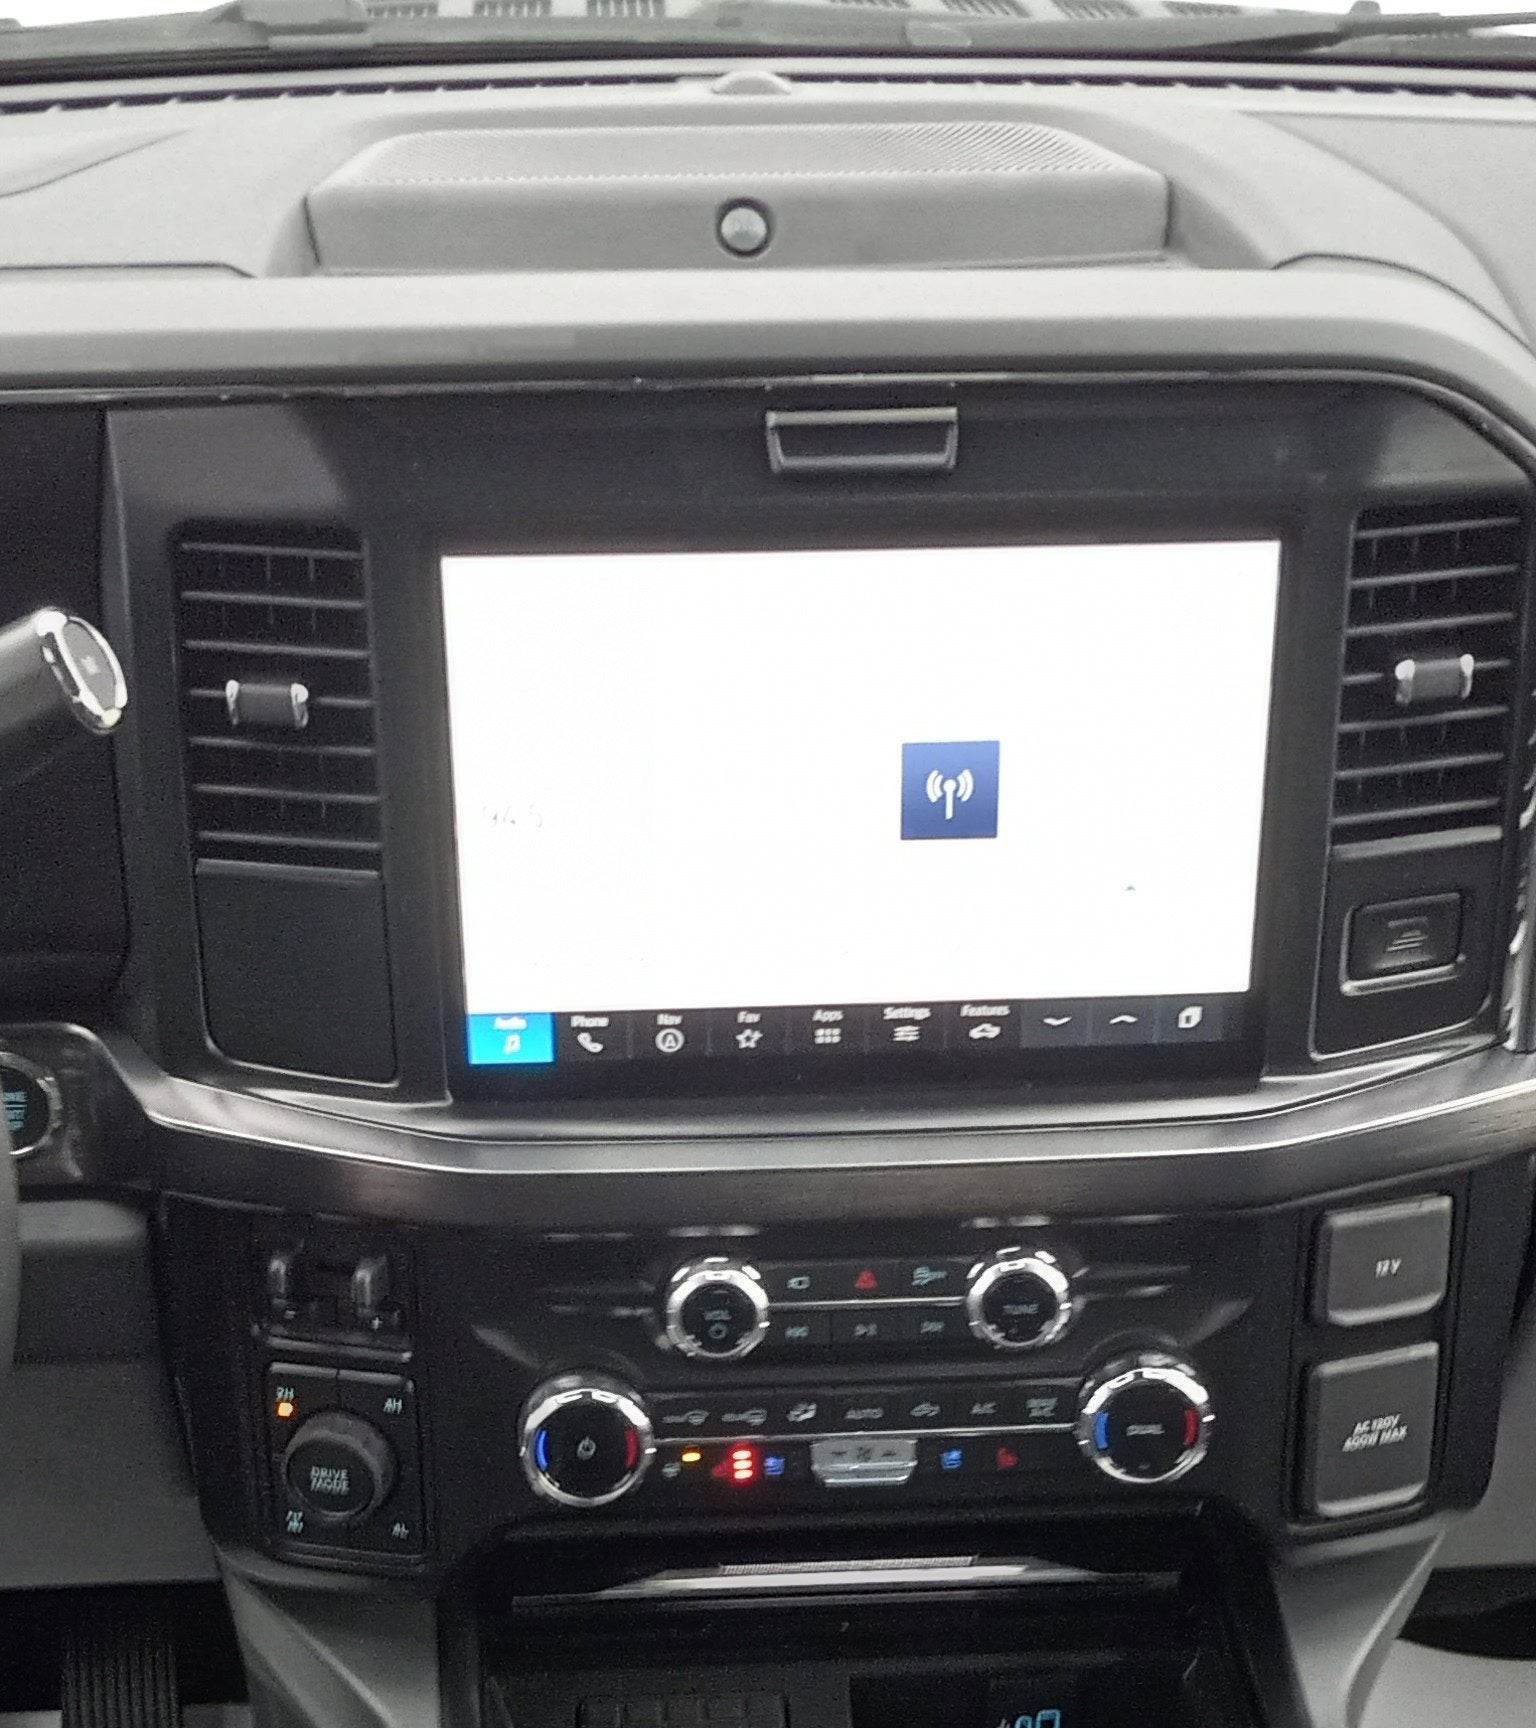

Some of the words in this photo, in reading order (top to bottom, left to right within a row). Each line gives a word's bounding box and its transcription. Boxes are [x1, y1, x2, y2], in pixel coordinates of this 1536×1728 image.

[737, 1010, 762, 1024] Fav
[812, 1009, 844, 1022] Apps
[883, 1007, 932, 1021] Settings
[960, 1004, 1012, 1017] Features
[570, 1014, 610, 1029] Phone
[310, 1466, 349, 1480] DRIVE
